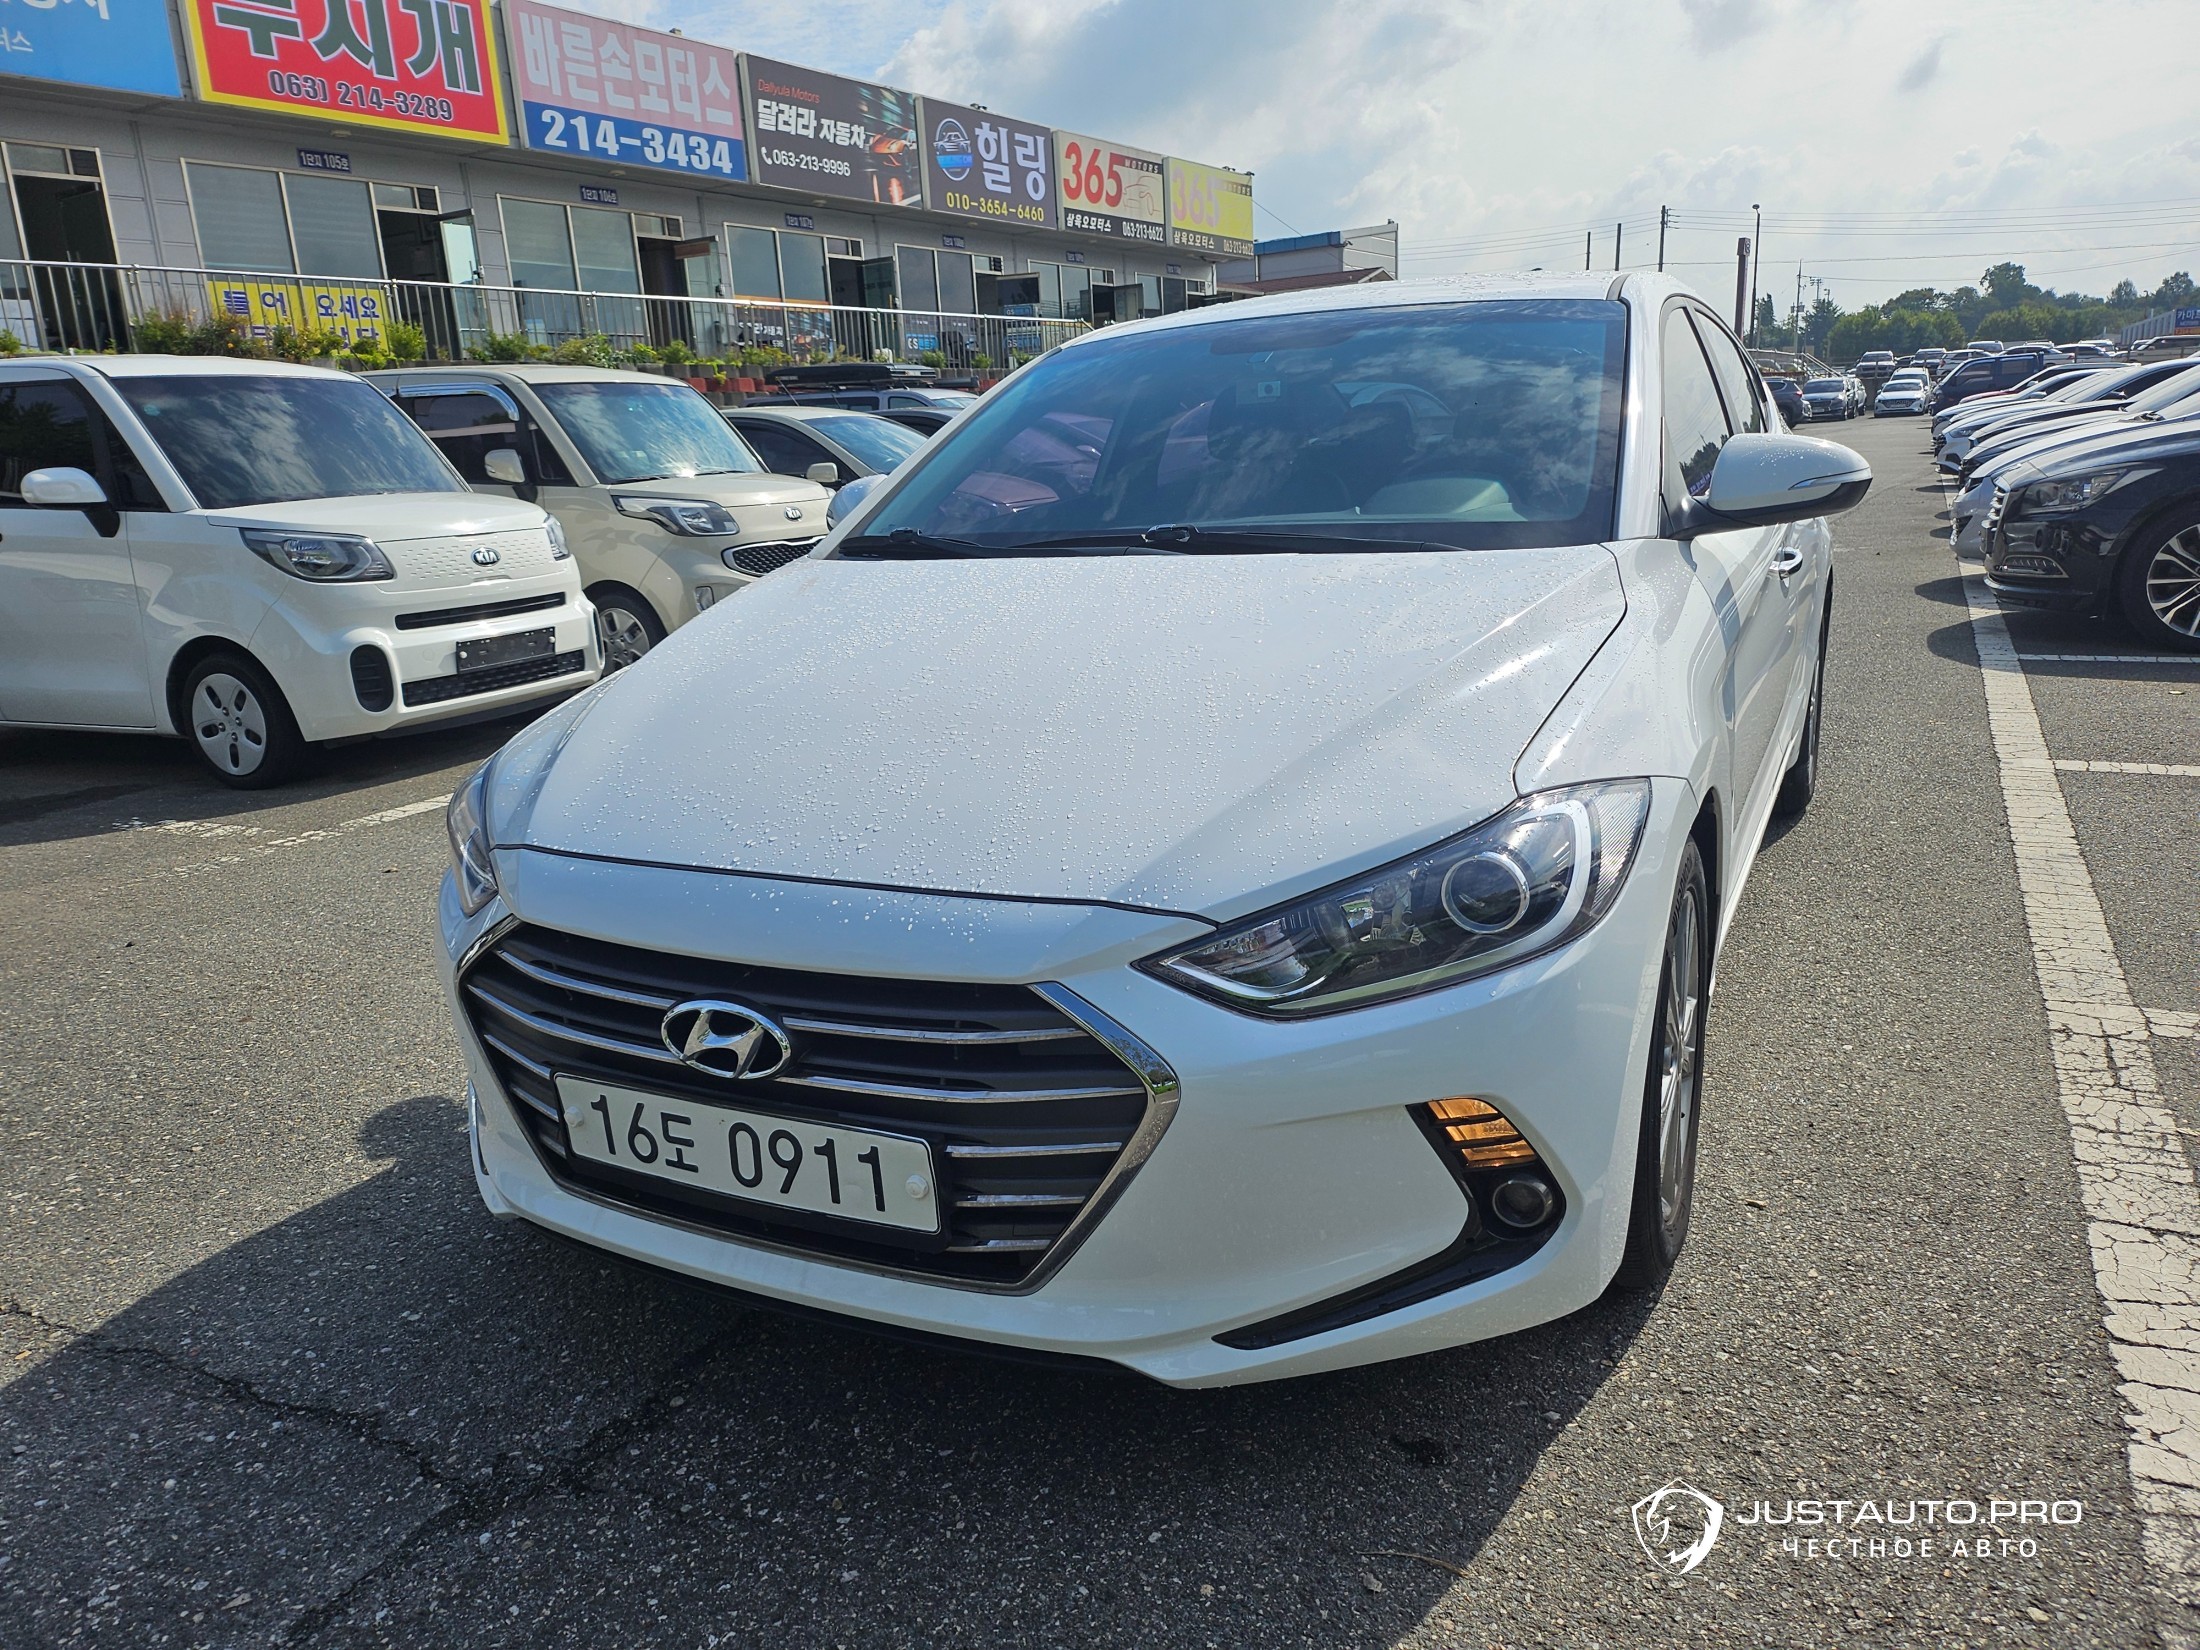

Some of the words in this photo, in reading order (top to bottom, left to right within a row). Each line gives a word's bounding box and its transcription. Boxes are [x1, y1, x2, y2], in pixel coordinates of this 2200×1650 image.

[518, 12, 734, 126] 바른손모터스
[268, 69, 329, 102] 063)
[336, 80, 454, 122] 214-3289
[791, 87, 820, 104] Motors
[757, 98, 817, 139] 달려라
[819, 118, 866, 149] 자동차
[541, 109, 733, 174] 214-3434
[300, 151, 322, 167] 1단지
[323, 153, 350, 171] 105호
[772, 149, 851, 177] 063-213-9996
[974, 121, 1046, 201] 힐링
[1063, 141, 1123, 208] 365
[1124, 158, 1159, 174] MOTORS
[946, 191, 1044, 222] 010-3654-6460
[1172, 165, 1220, 228] 365
[1066, 213, 1112, 233] 삼육오모터스
[1122, 221, 1164, 241] 063-213-6622
[1173, 230, 1215, 249] 삼육오모터스
[317, 294, 380, 319] 오세요
[473, 549, 499, 564] KIA
[590, 1094, 699, 1173] 16도
[728, 1121, 886, 1212] 0911
